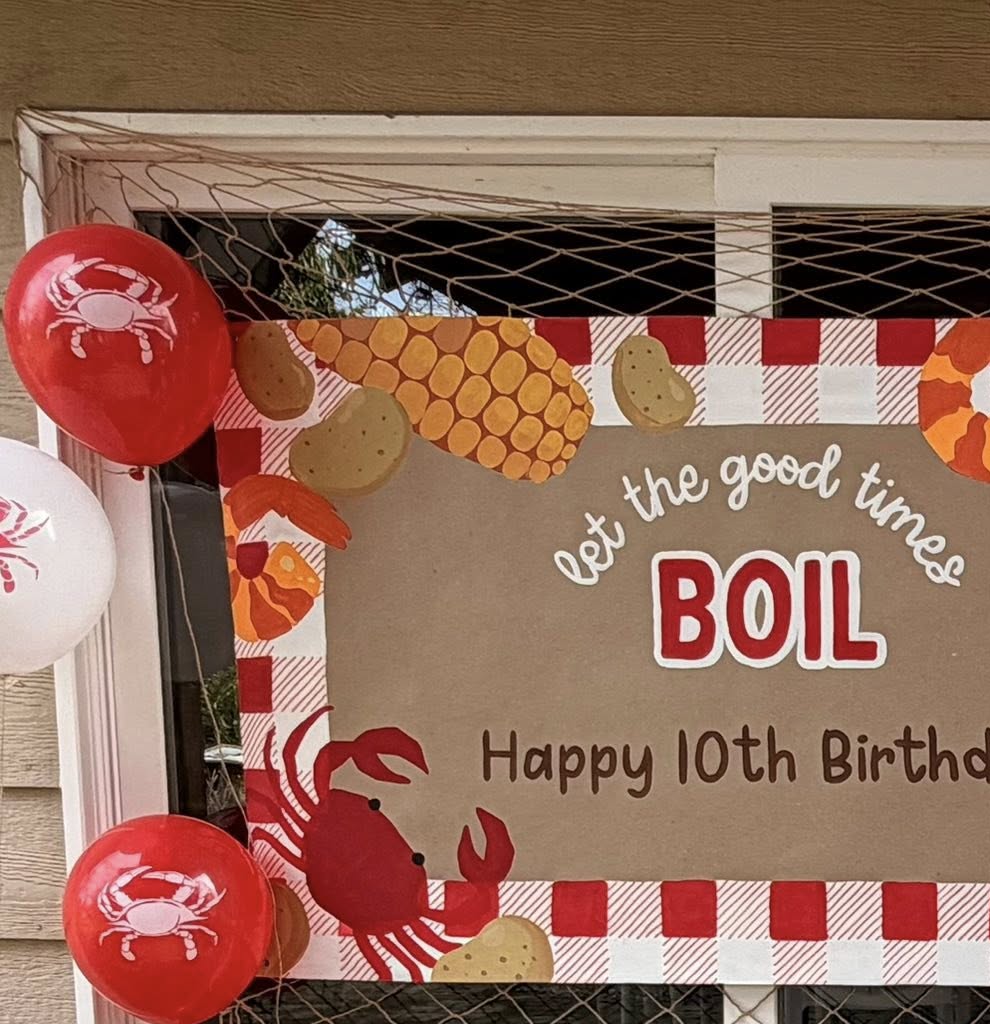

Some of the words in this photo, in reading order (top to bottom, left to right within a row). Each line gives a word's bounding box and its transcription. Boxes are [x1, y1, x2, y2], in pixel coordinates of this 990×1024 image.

[554, 512, 626, 586] let
[623, 464, 710, 523] the
[719, 443, 842, 511] good
[853, 461, 966, 588] times
[651, 550, 887, 669] BOIL
[482, 728, 654, 799] Happy
[678, 723, 797, 785] 10th
